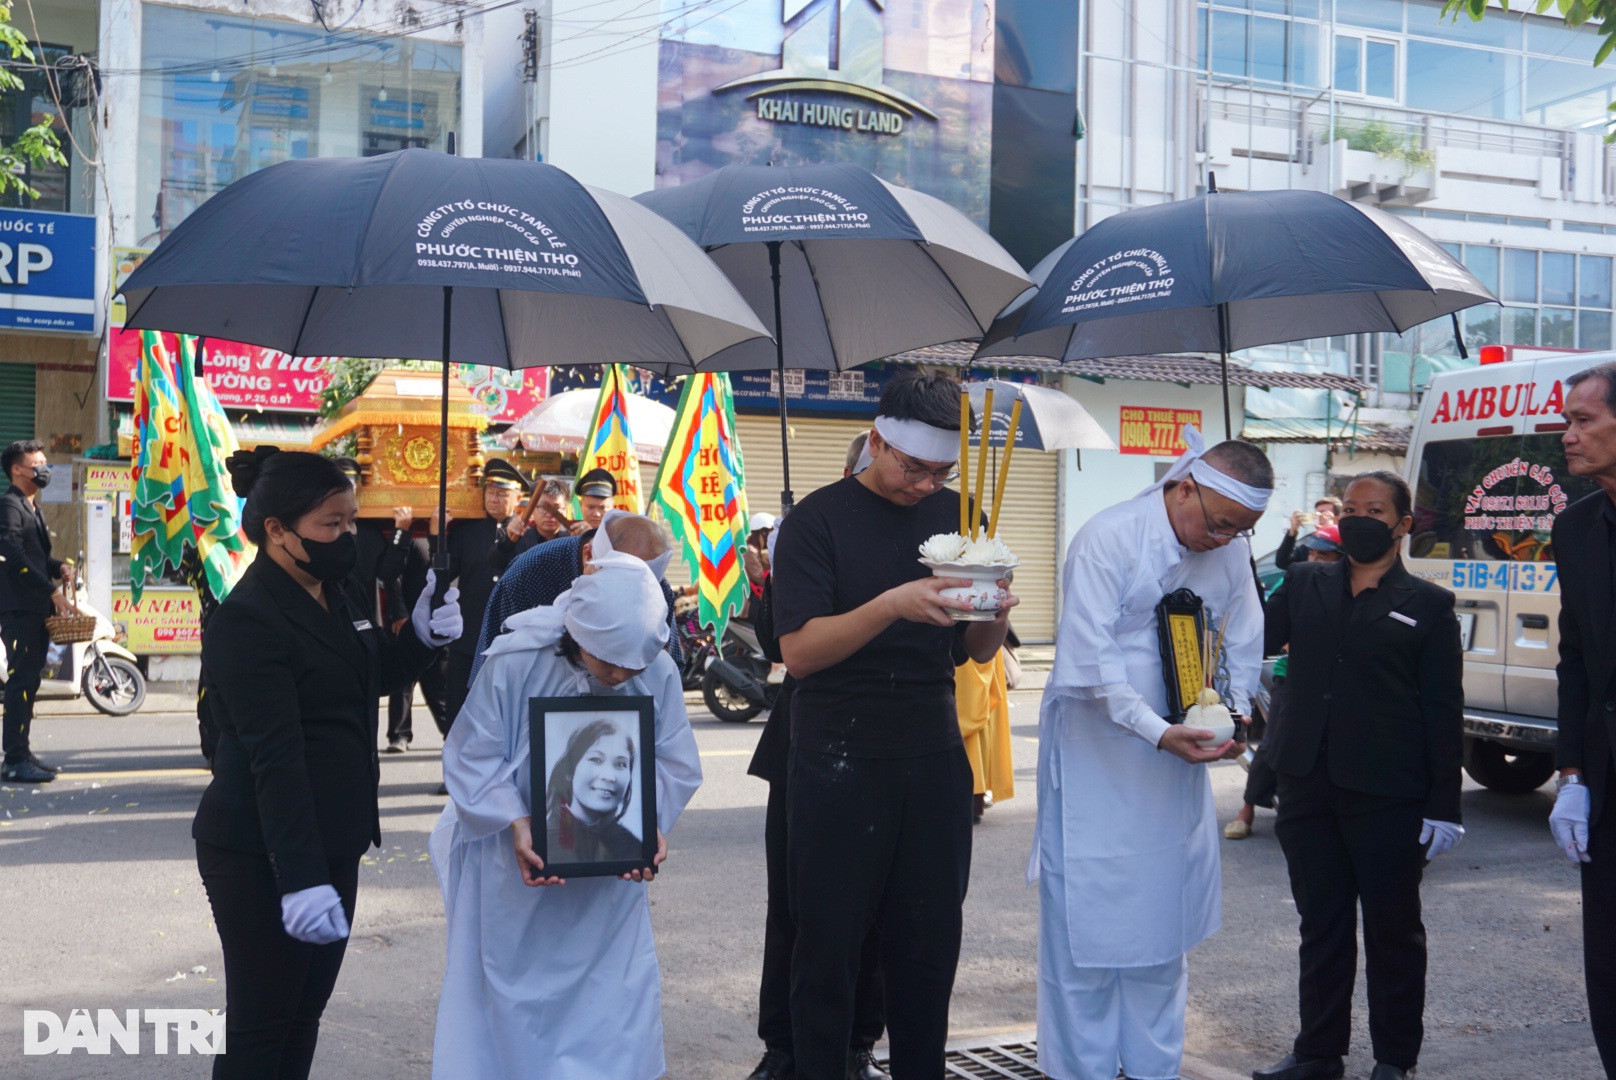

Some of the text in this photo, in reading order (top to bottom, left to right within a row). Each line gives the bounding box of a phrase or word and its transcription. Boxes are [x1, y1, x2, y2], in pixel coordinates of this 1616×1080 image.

[757, 97, 903, 134] KHAI HUNG LAND
[757, 190, 771, 199] TY
[820, 189, 847, 205] TANG
[38, 221, 55, 235] TẾ
[417, 210, 443, 238] CÔNG
[437, 203, 455, 215] TY
[454, 198, 475, 211] TỔ
[477, 201, 519, 217] CHỨC
[519, 211, 554, 237] TANG
[441, 216, 469, 238] CHUYÊN
[467, 214, 505, 224] NGHIỆP
[505, 220, 525, 233] CAO
[742, 212, 868, 224] PHƯỚC THIỆN THỌ
[415, 242, 580, 268] PHƯỚC THIỆN THỌ
[1093, 259, 1106, 270] TY
[1149, 250, 1167, 268] TANG
[1064, 277, 1175, 305] PHƯỚC THIỆN THỌ
[202, 349, 250, 372] Lòng
[1122, 409, 1200, 424] CHO THUÊ NHÀ
[1464, 485, 1487, 514] VẬN
[1464, 513, 1495, 530] PHÚC
[1537, 513, 1555, 530] TÂ
[148, 599, 193, 614] NEM
